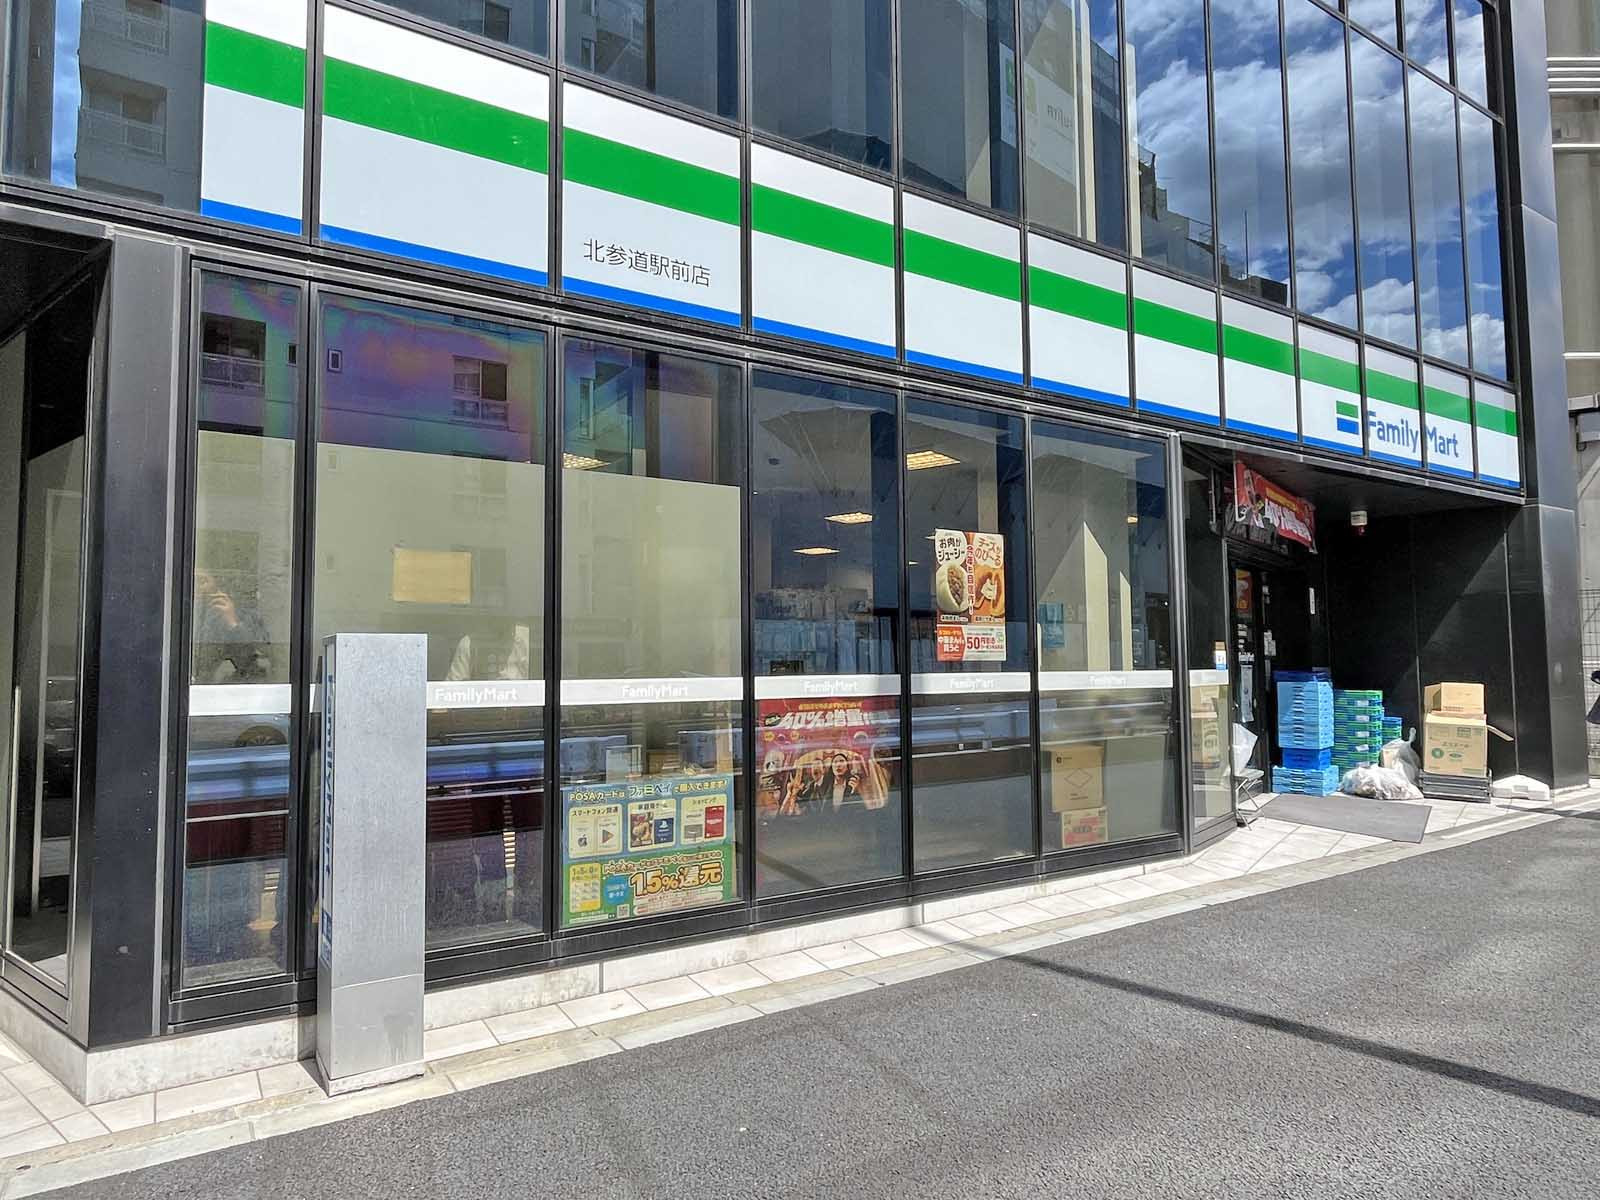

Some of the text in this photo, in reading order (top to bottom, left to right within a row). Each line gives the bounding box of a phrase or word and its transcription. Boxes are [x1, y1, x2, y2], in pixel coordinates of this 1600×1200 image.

[583, 238, 711, 288] 北参道駅前店
[938, 549, 965, 561] ジューシー
[435, 686, 518, 704] FamilyMart
[622, 684, 689, 700] FamilyMart
[803, 680, 858, 695] FamilyMart
[629, 782, 673, 798] ファミペイ
